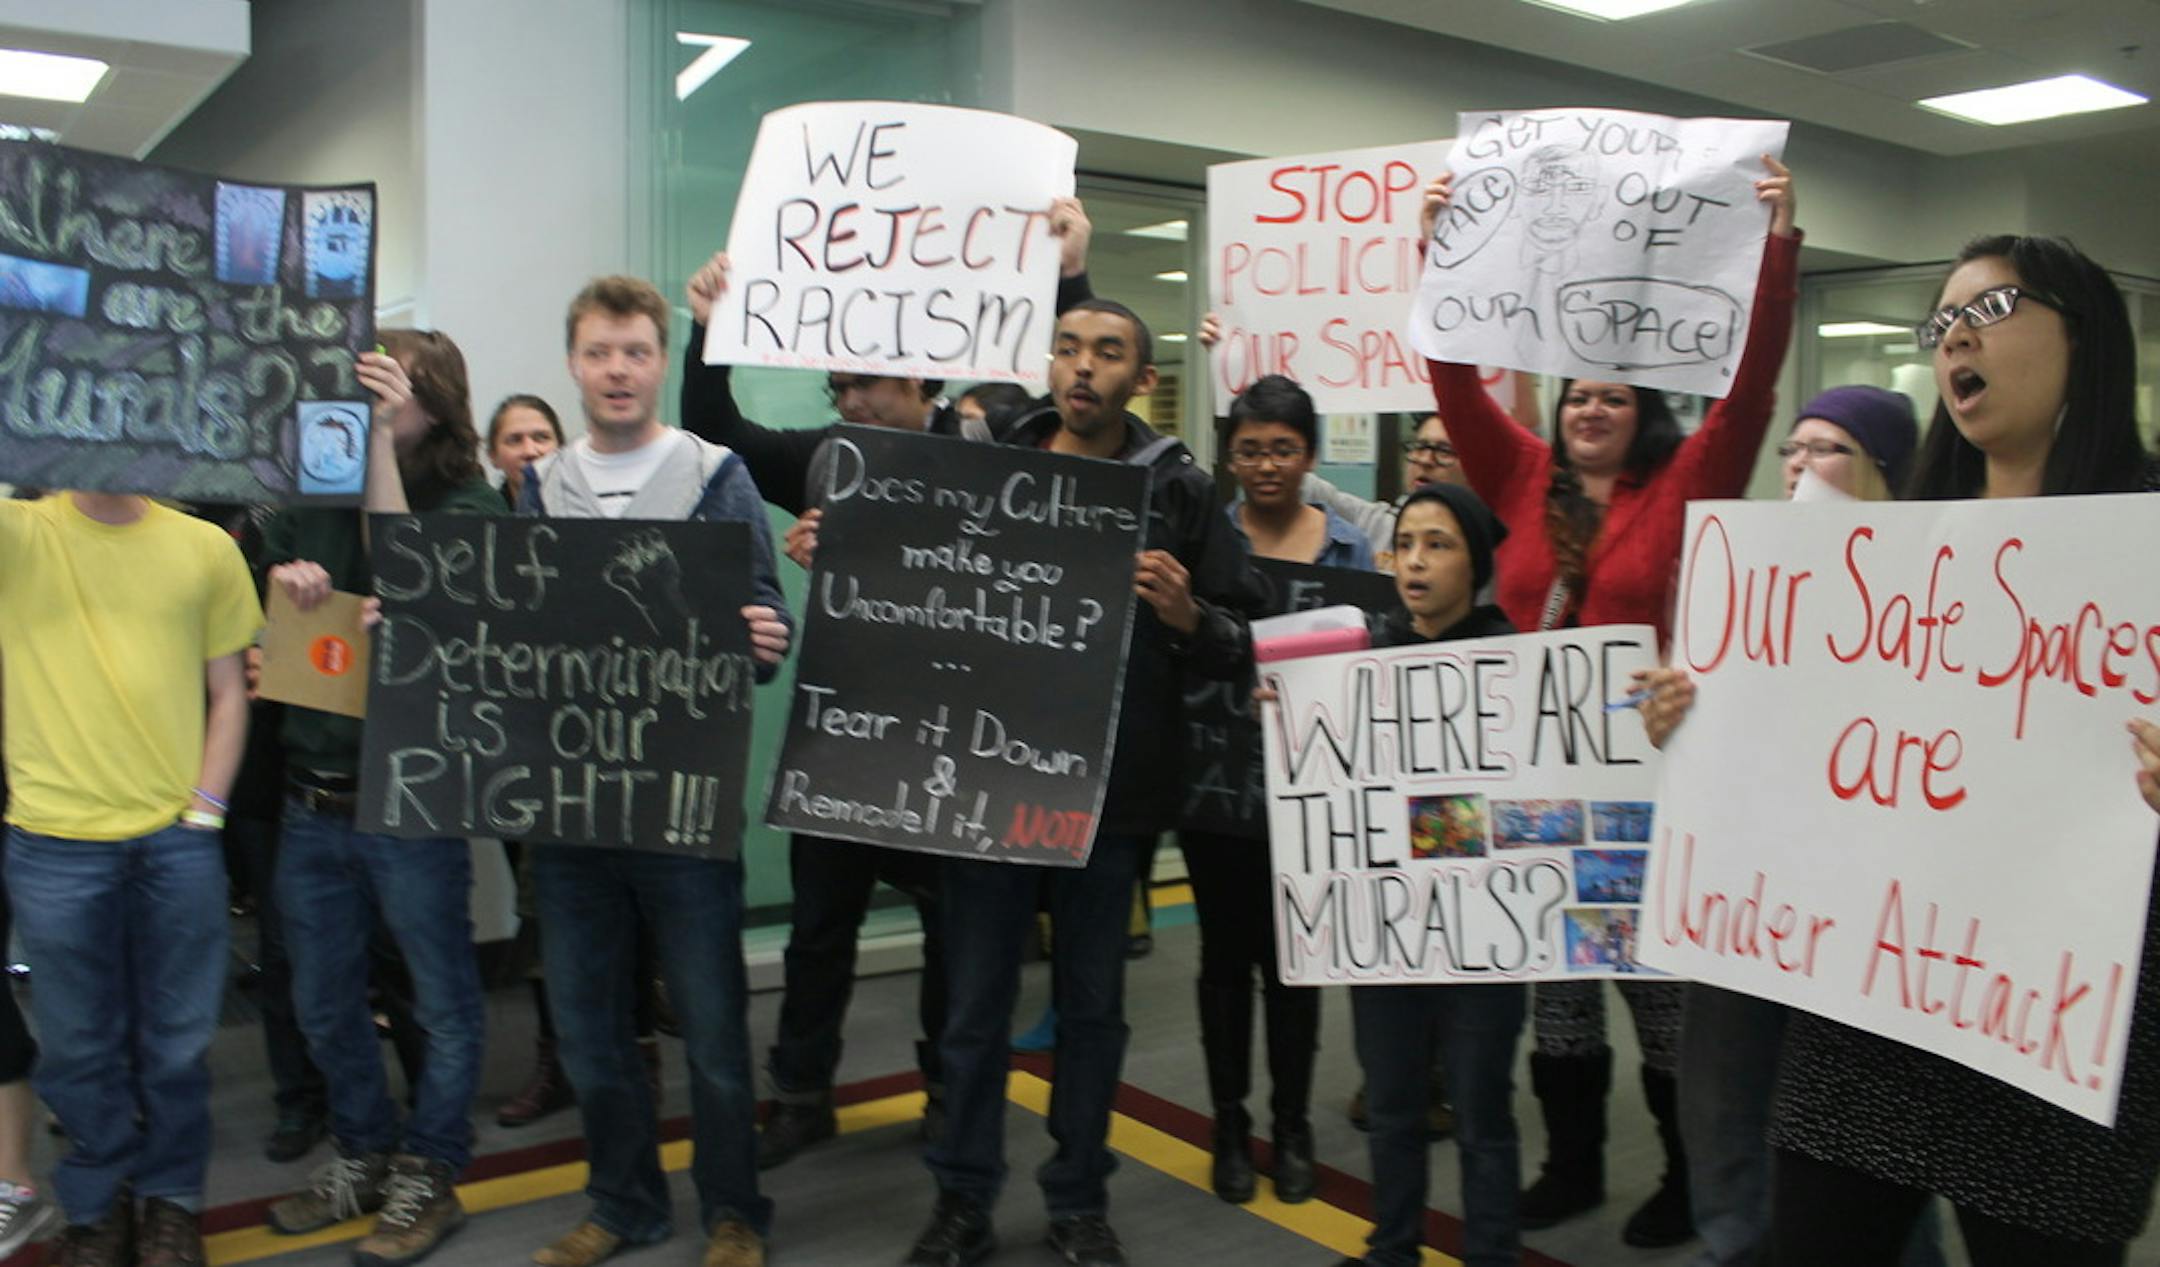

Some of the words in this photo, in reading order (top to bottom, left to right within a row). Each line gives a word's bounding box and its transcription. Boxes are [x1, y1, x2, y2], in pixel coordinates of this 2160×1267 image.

[803, 121, 907, 190] WE
[1255, 161, 1418, 224] STOP
[1616, 172, 1730, 226] OUT
[776, 199, 1050, 272] REJECT
[1221, 236, 1424, 305] POLICI
[1613, 220, 1683, 254] OF
[102, 281, 206, 334] are
[234, 284, 346, 343] the
[743, 279, 1035, 373] RACISM
[1433, 292, 1544, 341] OUR
[1221, 328, 1300, 394] OUR
[828, 438, 925, 502] Does
[934, 485, 1001, 536] my
[372, 517, 559, 611] Self
[901, 539, 994, 575] make
[994, 557, 1064, 593] you
[821, 572, 1104, 652] Uncomfortable?
[1683, 513, 1813, 675] Our
[1826, 526, 1965, 682] Safe
[1977, 538, 2160, 740] Spaces
[378, 614, 755, 719] Determination
[437, 691, 507, 757] is
[799, 682, 901, 741] Tear
[915, 705, 951, 748] it
[969, 708, 1088, 779] Down
[1270, 660, 1507, 785] WHERE
[1531, 641, 1643, 766] ARE
[922, 754, 957, 798] &
[1828, 716, 1967, 811] are
[778, 769, 940, 836] Remodel
[1277, 787, 1398, 875] THE
[1284, 863, 1568, 971] MURALS?
[1657, 826, 1836, 980] Under
[1861, 878, 2123, 1093] Attack!
